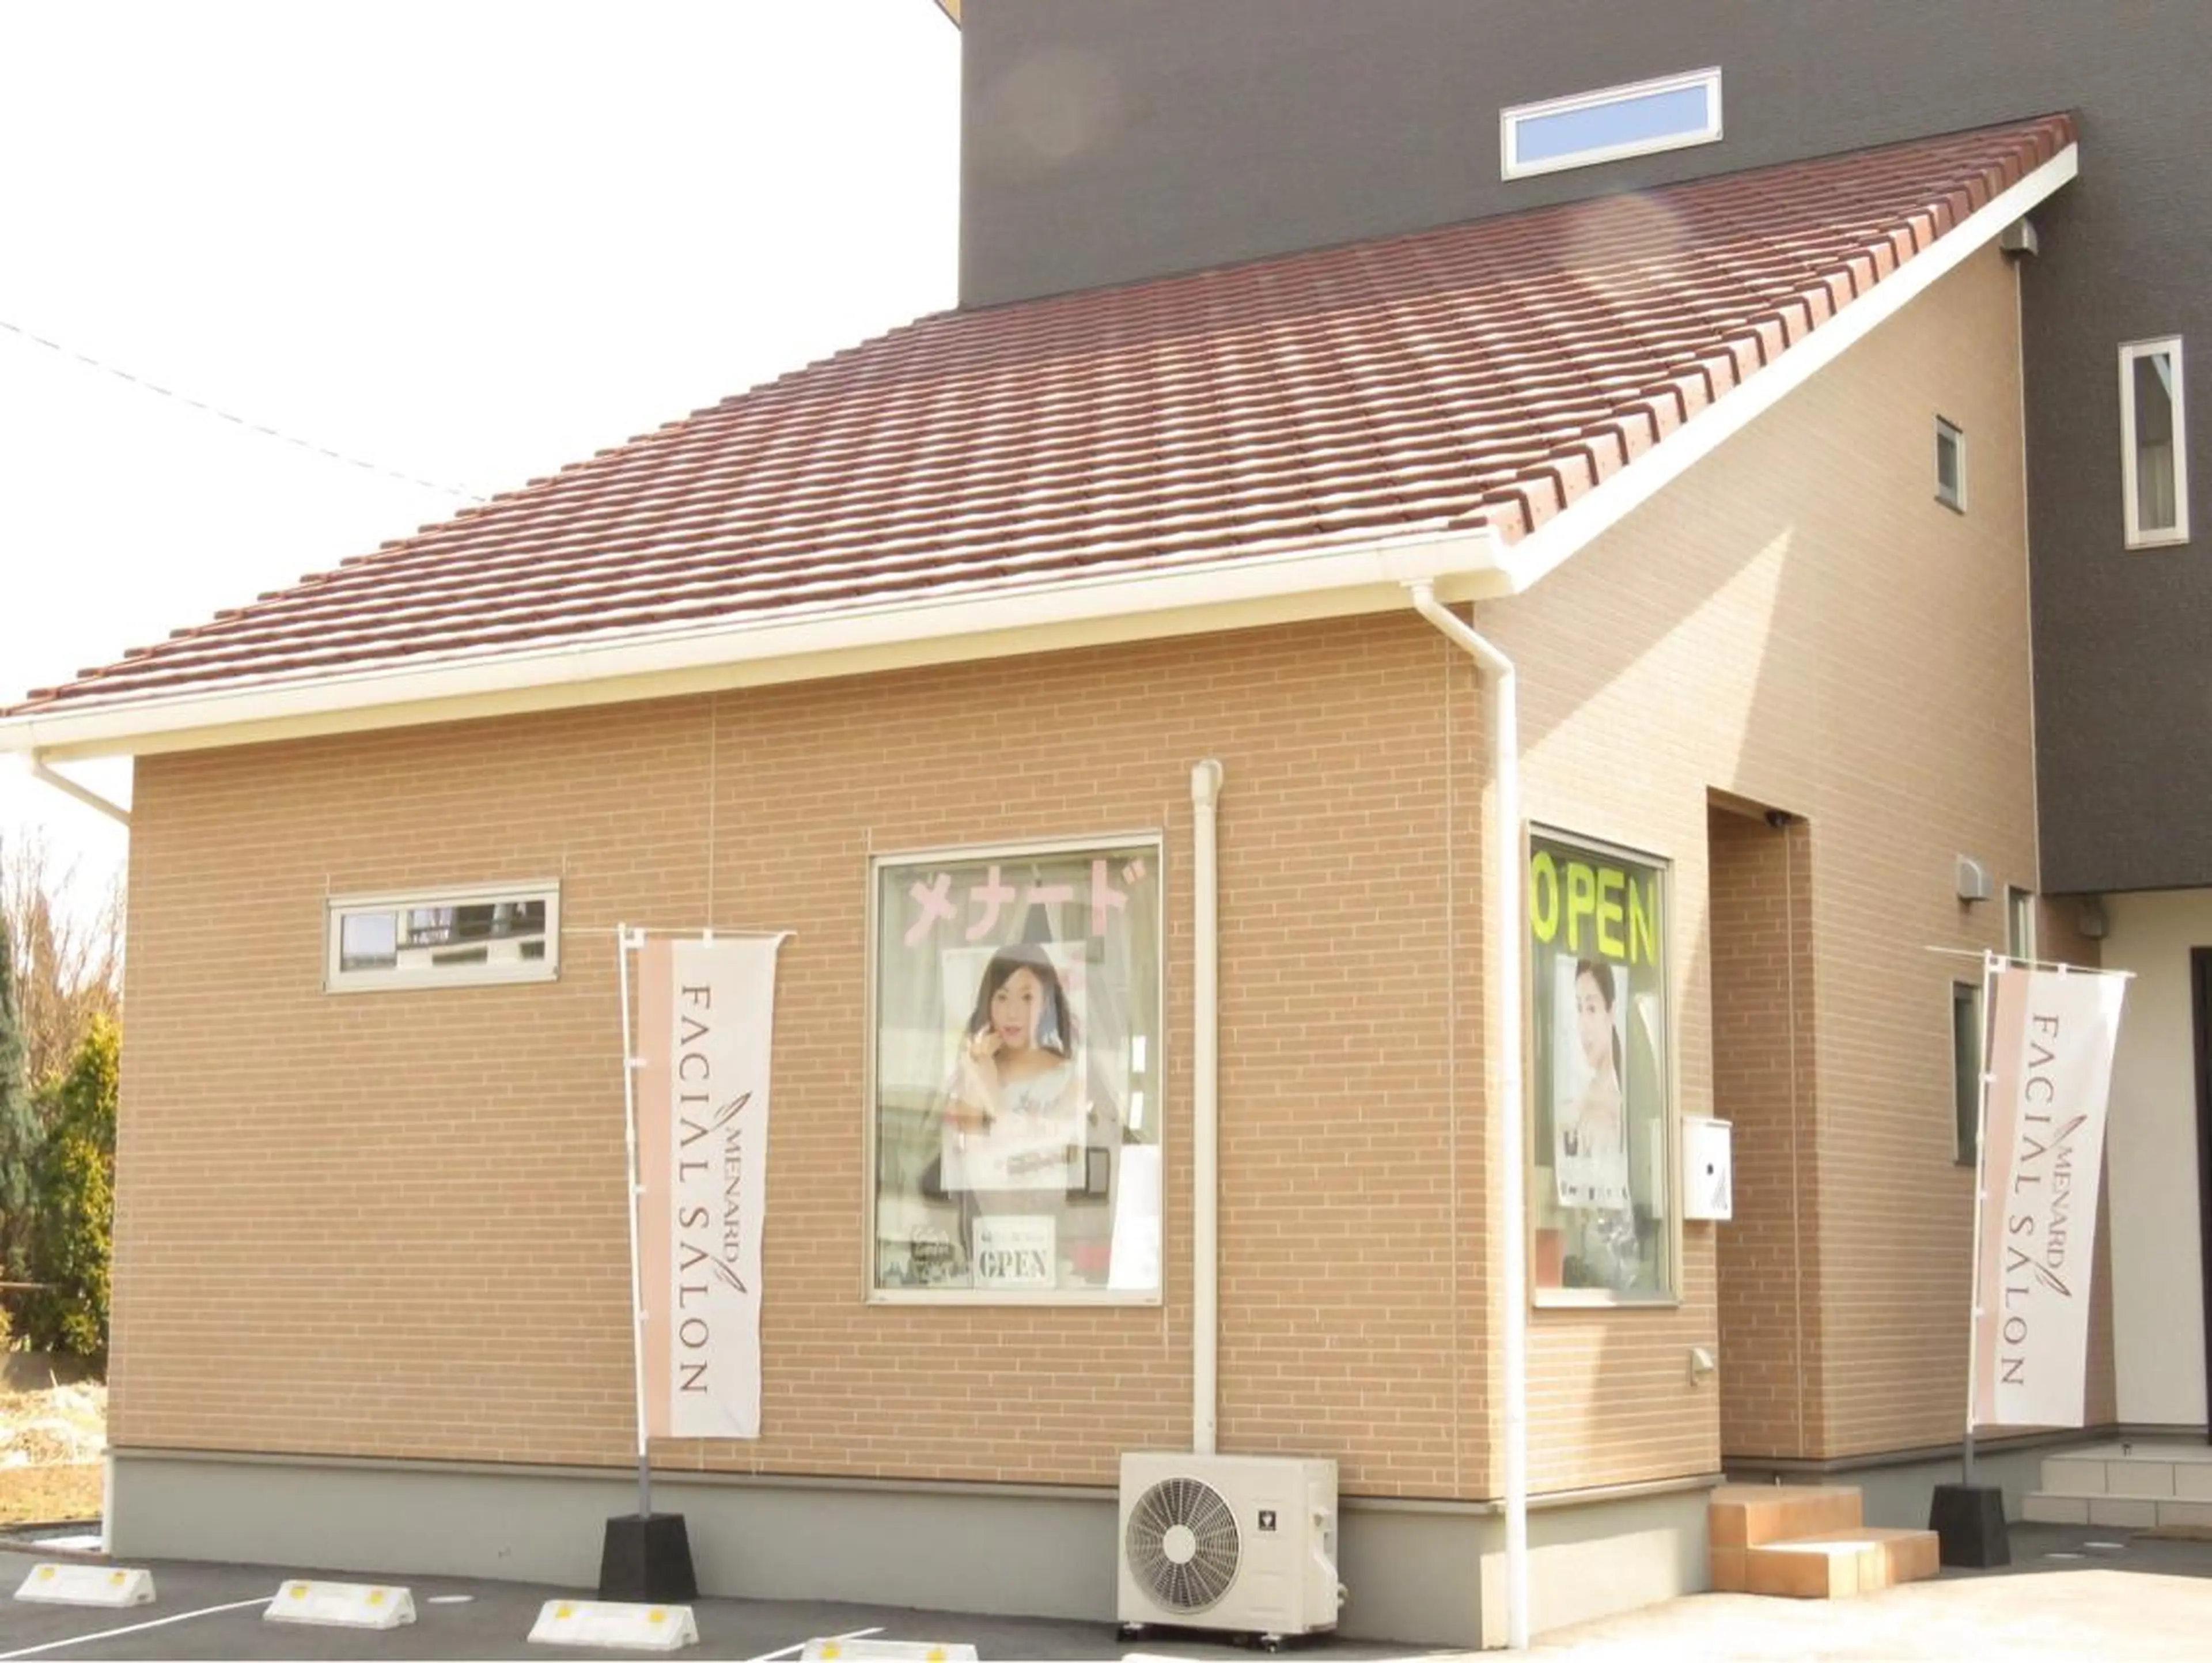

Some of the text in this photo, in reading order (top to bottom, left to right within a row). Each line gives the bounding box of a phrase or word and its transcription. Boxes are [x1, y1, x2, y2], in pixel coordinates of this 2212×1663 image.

[904, 856, 1146, 947] メナード
[1530, 851, 1656, 965] OPEN
[678, 986, 710, 1394] FACIAL SALON
[724, 1127, 742, 1263] MENARD
[2001, 1013, 2058, 1385] FACIAL SALON
[2047, 1147, 2074, 1268] MENARD
[979, 1248, 1047, 1279] OPEN
